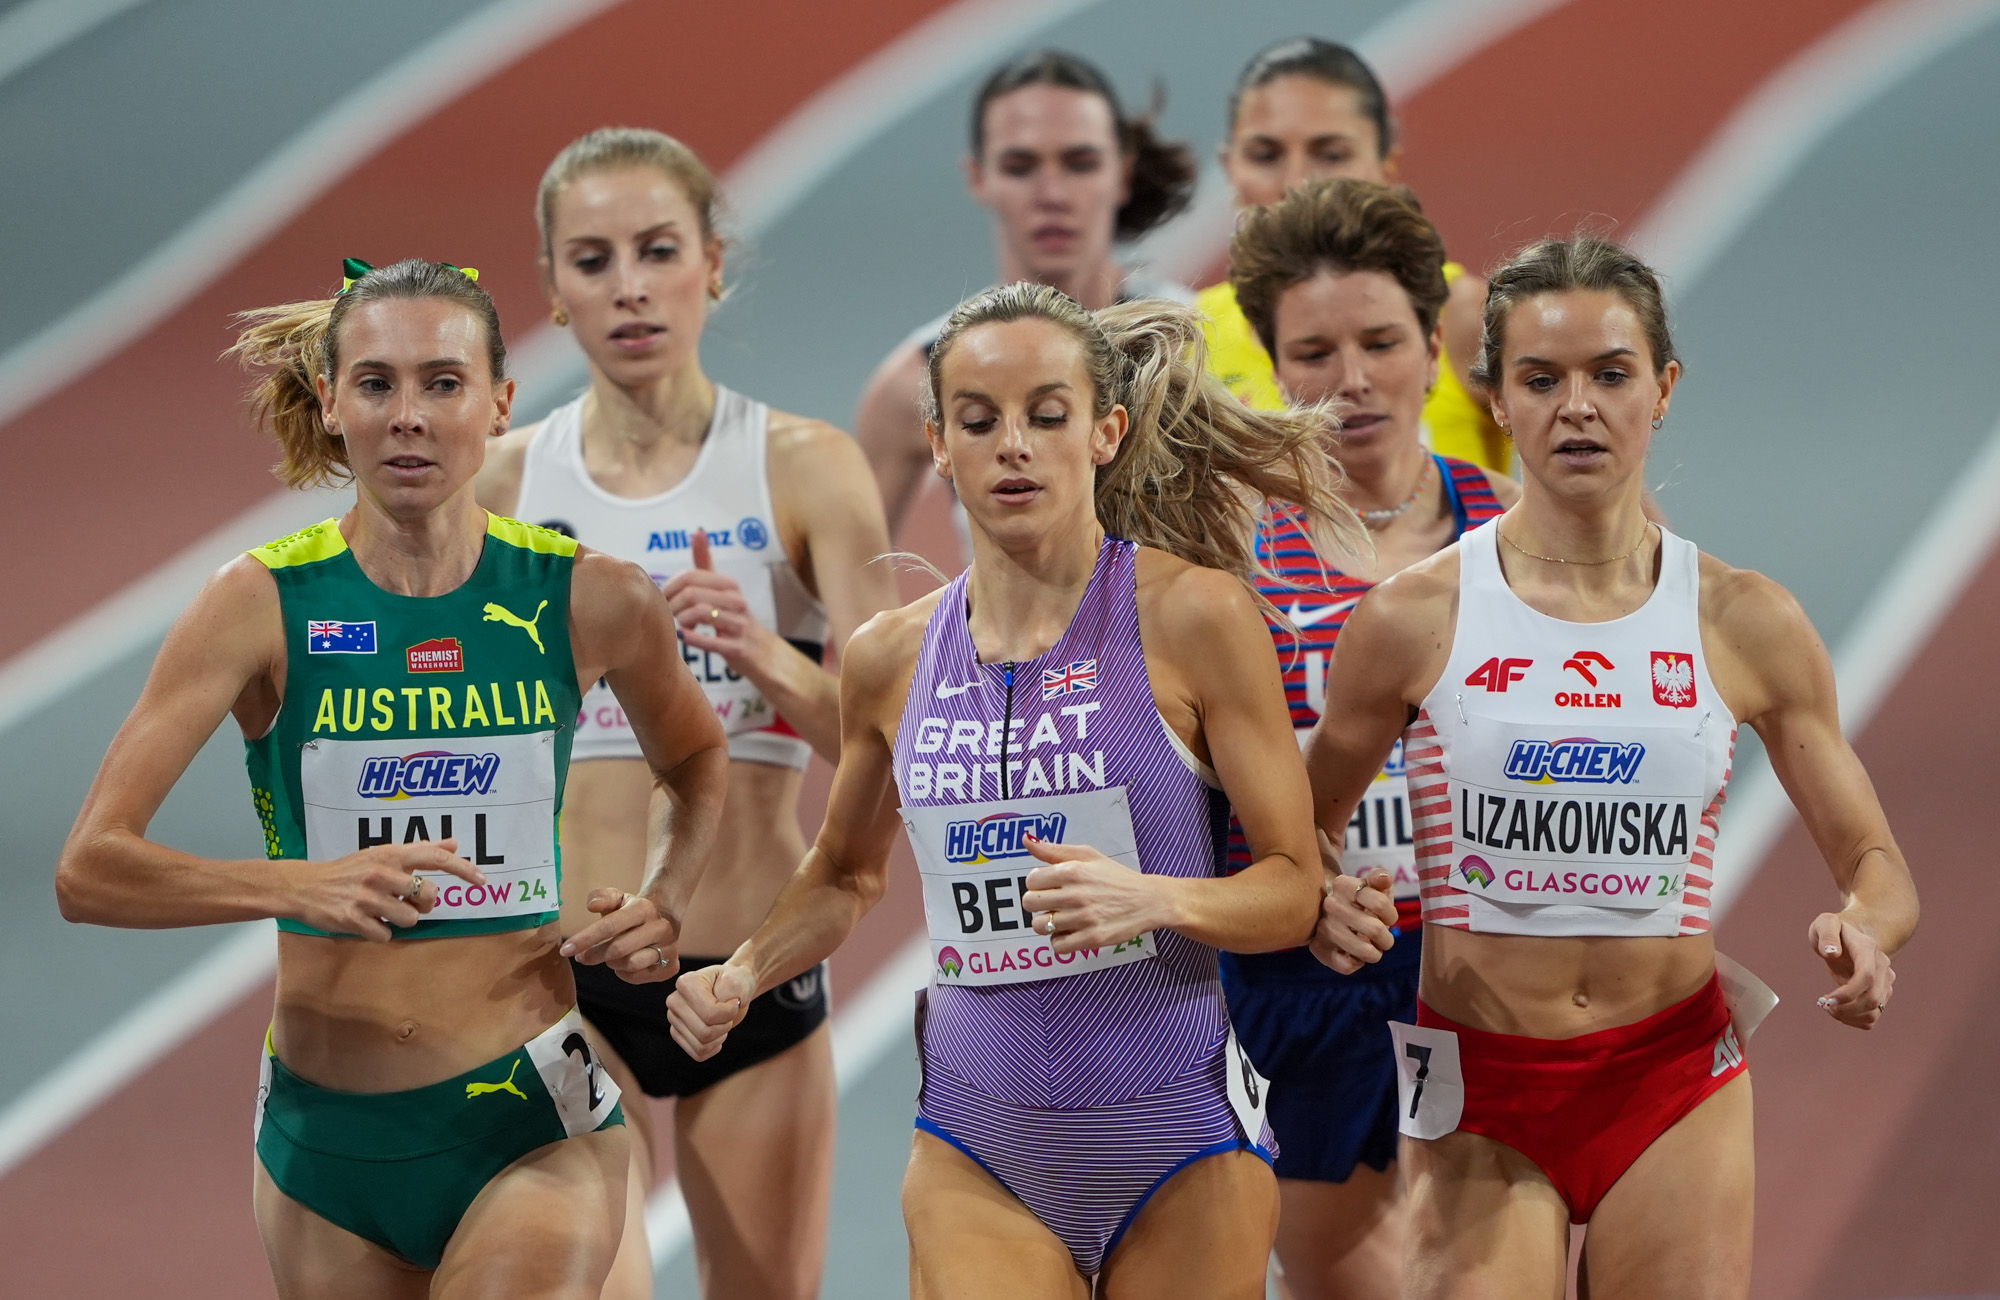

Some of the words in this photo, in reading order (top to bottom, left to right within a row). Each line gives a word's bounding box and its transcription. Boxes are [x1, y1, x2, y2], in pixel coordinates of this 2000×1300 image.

[647, 530, 734, 552] Allinz
[410, 650, 459, 662] CHEMIST
[411, 661, 459, 669] WAREHOUSE
[1465, 657, 1534, 693] 4F
[312, 680, 556, 733] AUSTRALIA
[1554, 692, 1621, 708] ORLEN
[915, 702, 1101, 756] GREAT
[357, 753, 500, 798] HI-CHEW
[909, 751, 1106, 800] BRITAIN
[1502, 740, 1646, 785] HI-CHEW
[1462, 788, 1688, 856] LIZAKOWSKA
[518, 879, 547, 902] 24
[1504, 869, 1651, 896] GLASGOW
[561, 1032, 607, 1112] 2
[1406, 1042, 1432, 1119] 7
